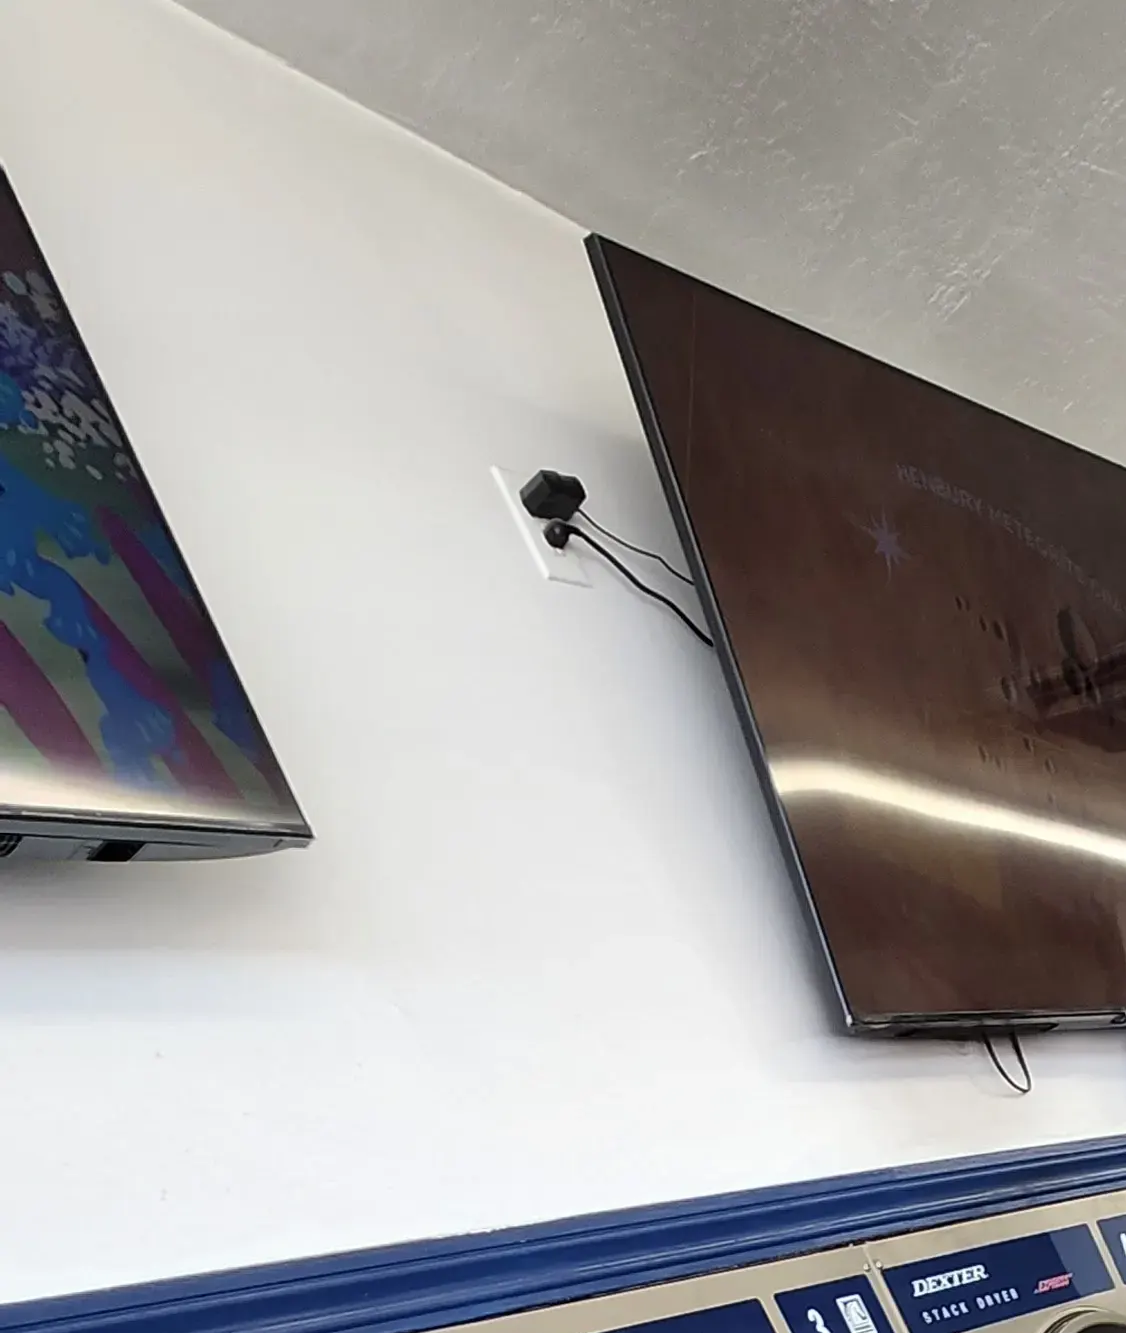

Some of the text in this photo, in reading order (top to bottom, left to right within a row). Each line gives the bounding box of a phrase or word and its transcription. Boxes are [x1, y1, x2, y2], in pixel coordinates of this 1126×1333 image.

[911, 1264, 989, 1298] DEXTER
[922, 1287, 1020, 1325] STACK DRYER
